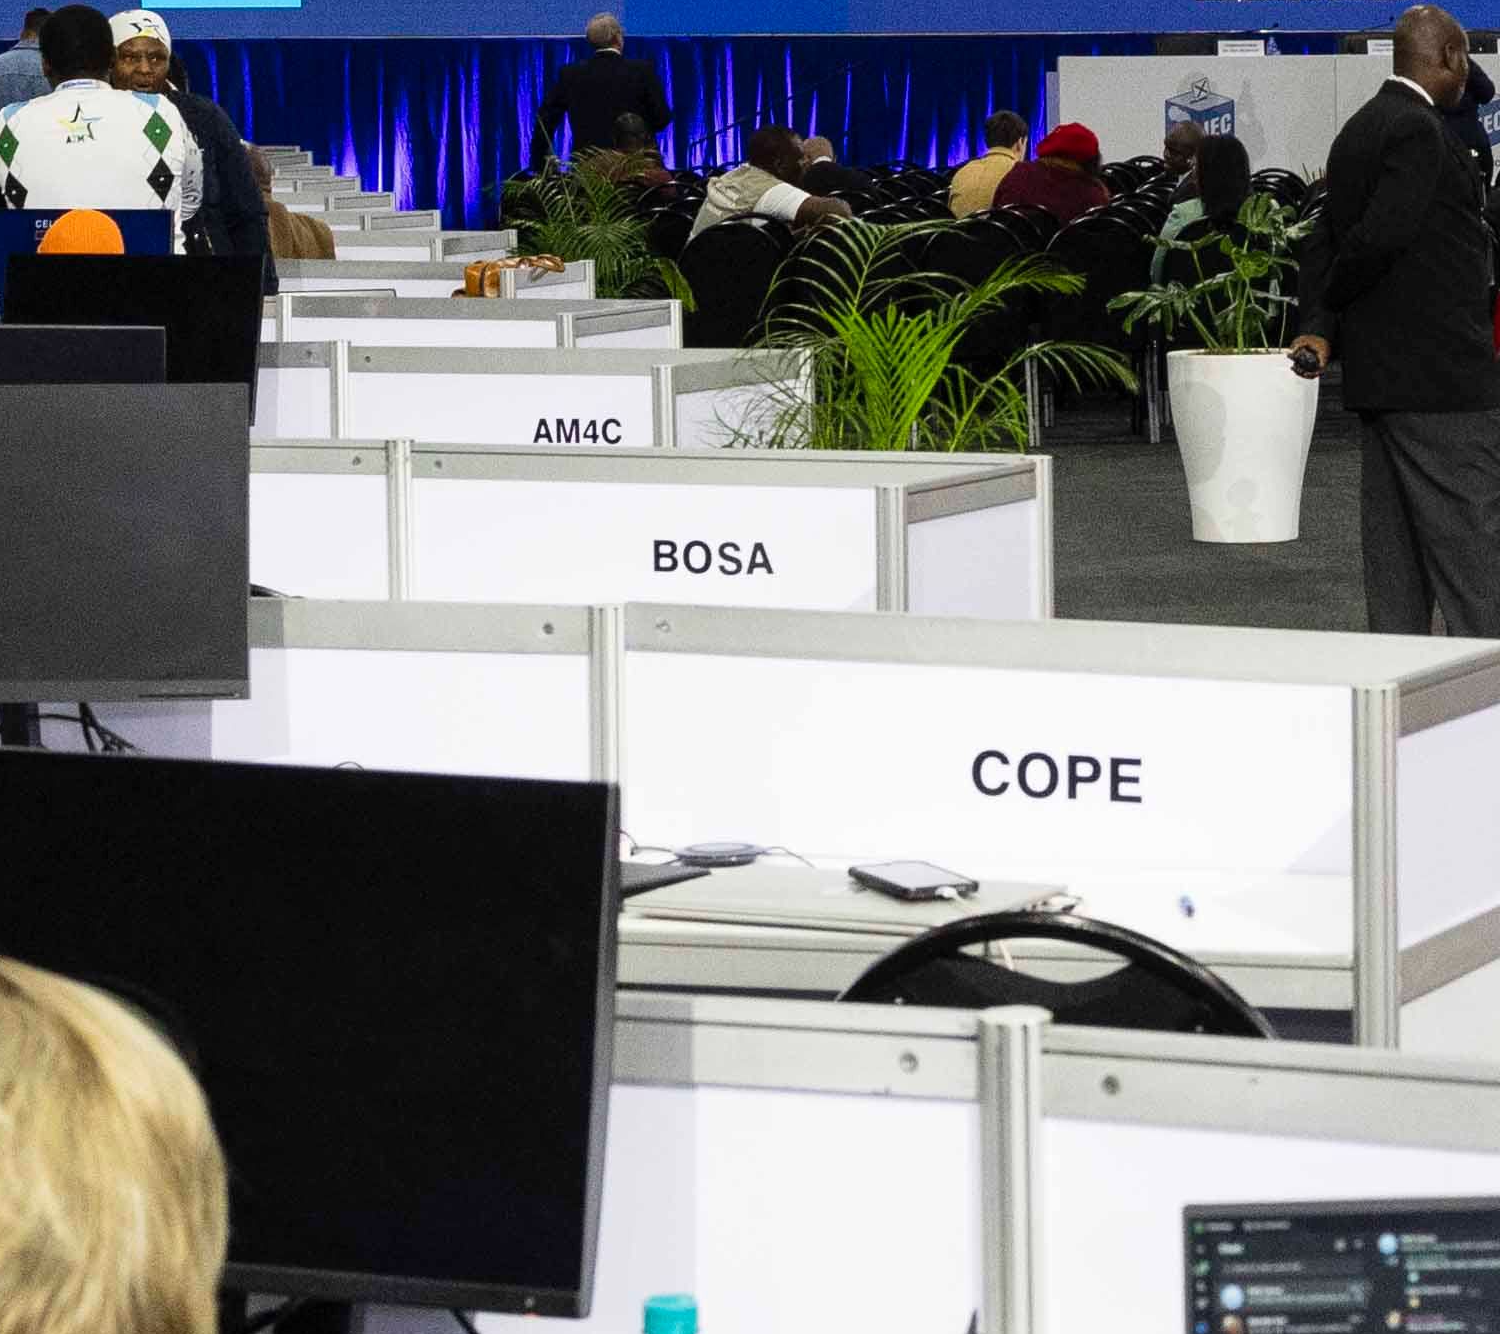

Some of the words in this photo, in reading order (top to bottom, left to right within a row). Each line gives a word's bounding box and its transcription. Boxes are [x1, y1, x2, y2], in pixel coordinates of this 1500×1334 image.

[534, 419, 621, 444] AM4C
[654, 540, 773, 575] BOSA
[972, 750, 1141, 803] COPE
